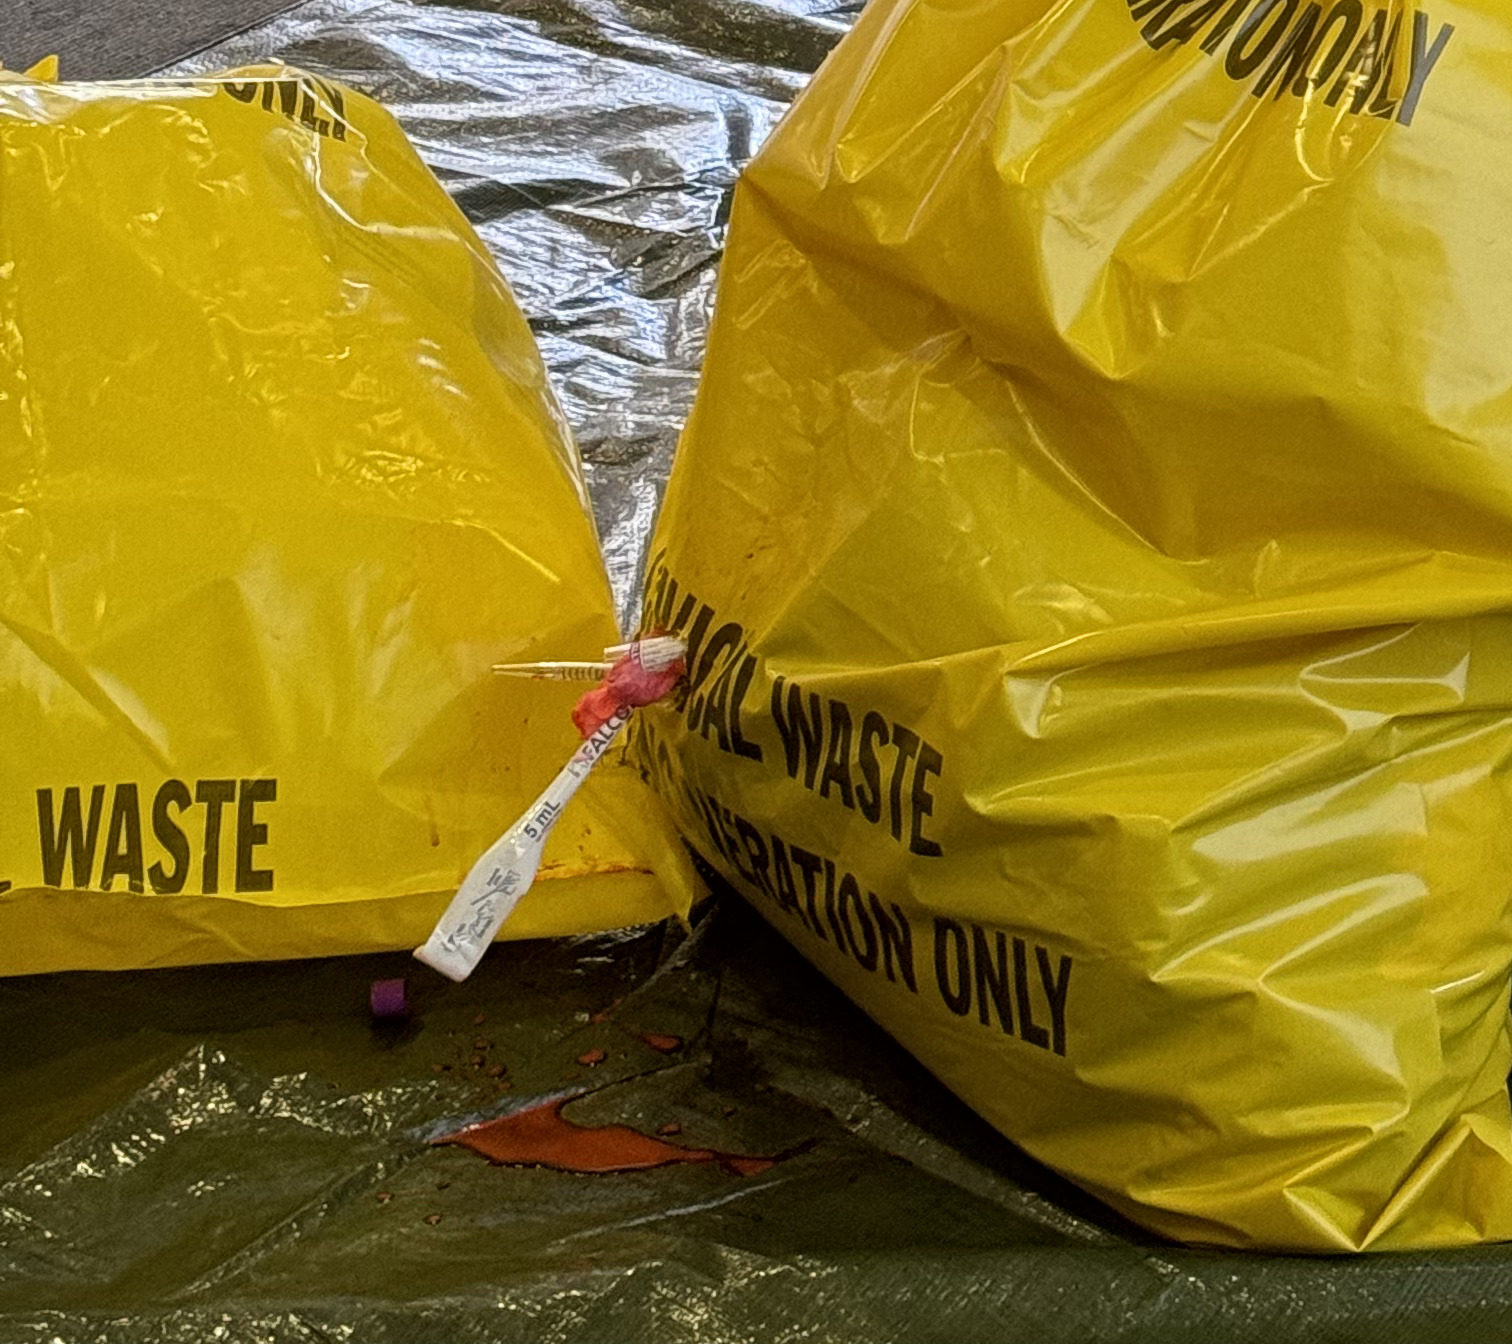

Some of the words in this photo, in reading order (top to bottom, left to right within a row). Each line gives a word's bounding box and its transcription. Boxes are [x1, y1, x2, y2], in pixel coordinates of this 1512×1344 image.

[523, 821, 538, 840] 5
[535, 799, 561, 827] mL
[771, 675, 944, 858] WASTE
[36, 779, 277, 895] WASTE
[934, 917, 1072, 1058] ONLY
